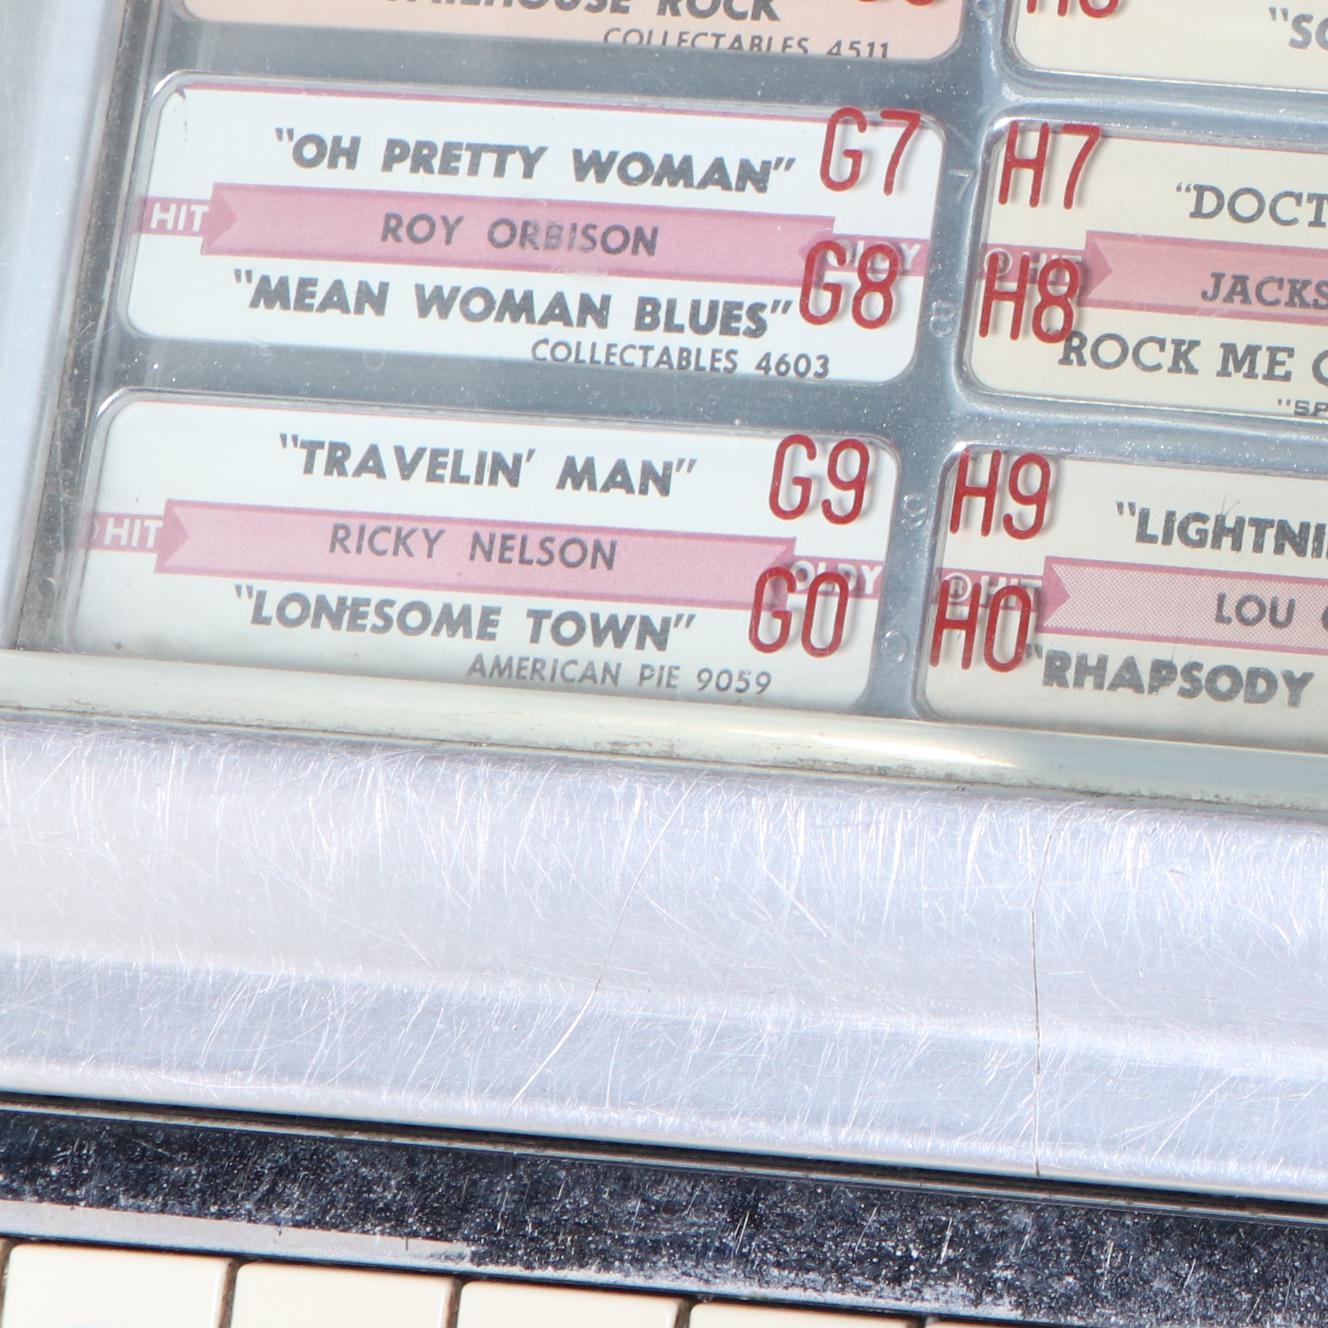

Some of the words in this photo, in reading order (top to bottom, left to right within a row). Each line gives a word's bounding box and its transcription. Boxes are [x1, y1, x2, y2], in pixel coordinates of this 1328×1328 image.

[274, 128, 362, 170] "OH
[382, 137, 548, 179] PRETTY
[572, 148, 795, 194] WOMAN"
[820, 106, 920, 194] G7
[150, 204, 207, 231] HIT
[381, 212, 463, 246] ROY
[487, 218, 660, 256] ORBISON
[980, 252, 1080, 343] H8
[530, 336, 740, 374] COLLECTABLES
[754, 350, 831, 379] 4603
[279, 433, 536, 488] "TRAVELIN'
[556, 454, 696, 496] MAN"
[768, 434, 870, 525] G9
[328, 522, 444, 559] RICKY
[469, 532, 618, 570] NELSON
[234, 584, 500, 640] "LONESOME
[527, 608, 696, 651] TOWN"
[931, 581, 1033, 672] H0
[1214, 592, 1296, 629] LOU
[467, 651, 624, 687] AMERICAN
[638, 663, 680, 690] PIE
[695, 667, 774, 697] 9059
